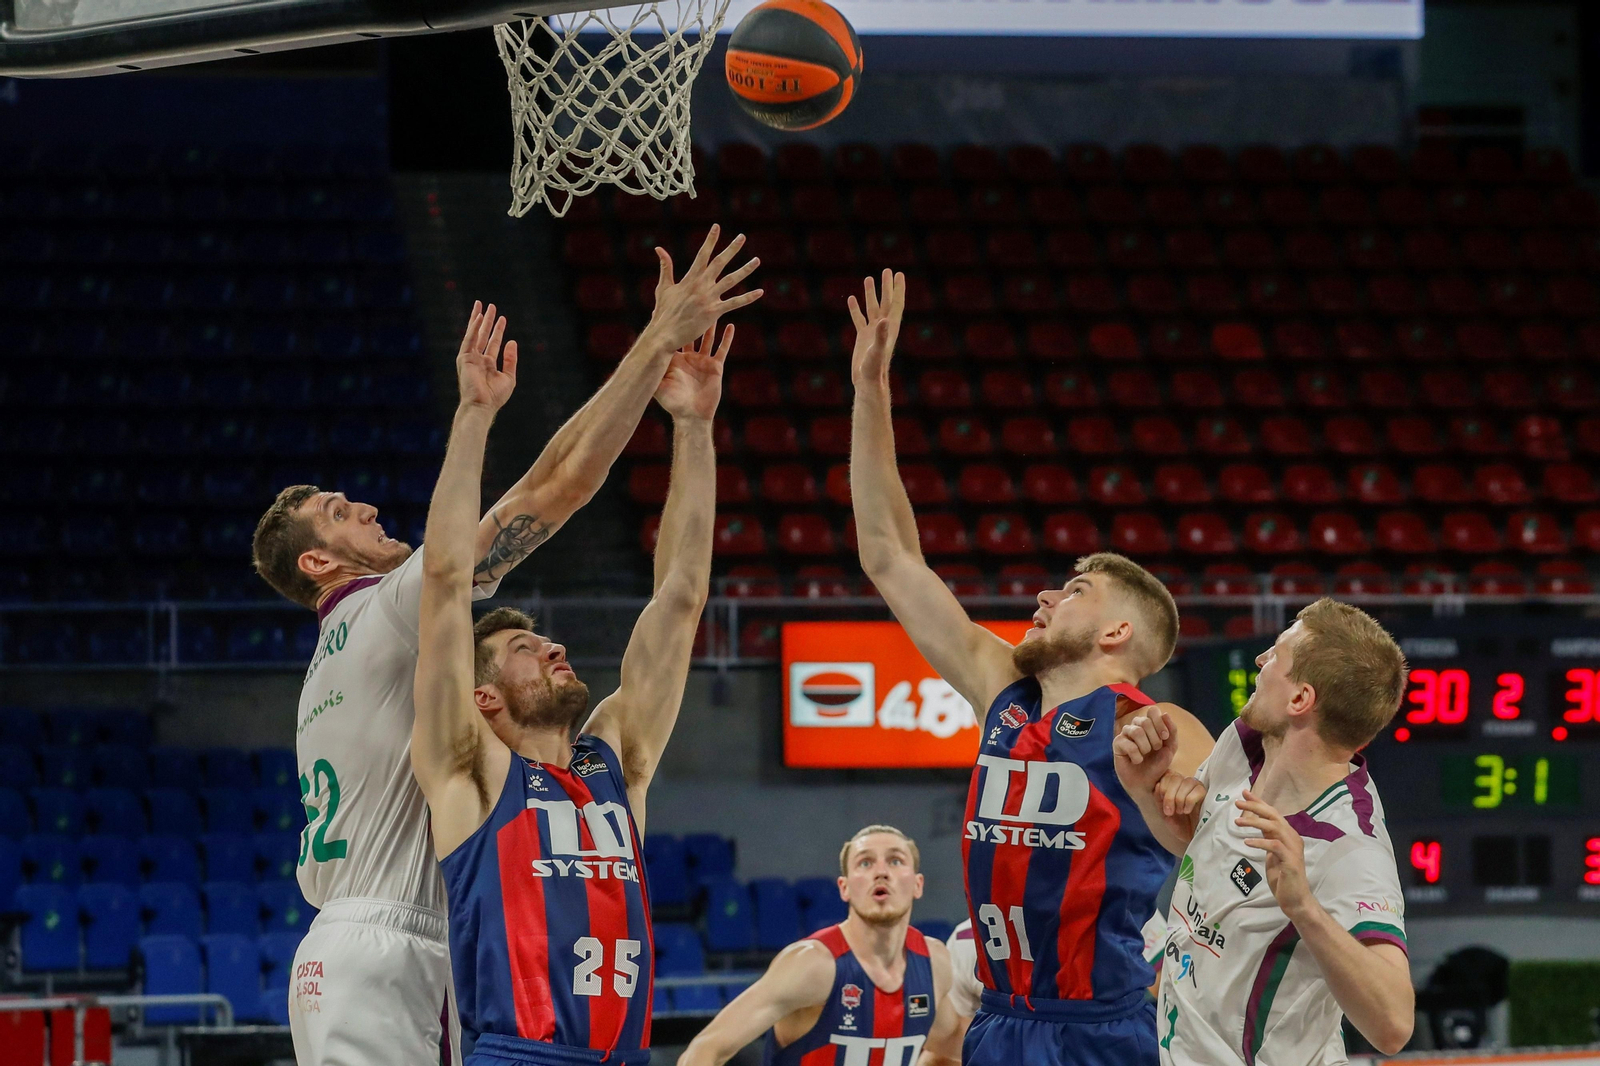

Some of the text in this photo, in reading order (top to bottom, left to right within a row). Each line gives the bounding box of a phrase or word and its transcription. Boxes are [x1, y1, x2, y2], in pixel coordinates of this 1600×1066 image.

[1406, 669, 1471, 724] 30
[1492, 672, 1525, 720] 2
[1563, 668, 1600, 724] 3
[977, 753, 1090, 826] TD
[526, 798, 635, 860] TD
[964, 820, 1087, 850] SYSTEMS
[1410, 841, 1442, 883] 4
[978, 903, 1035, 962] 31
[1187, 895, 1226, 949] Uniaja
[573, 937, 641, 998] 25
